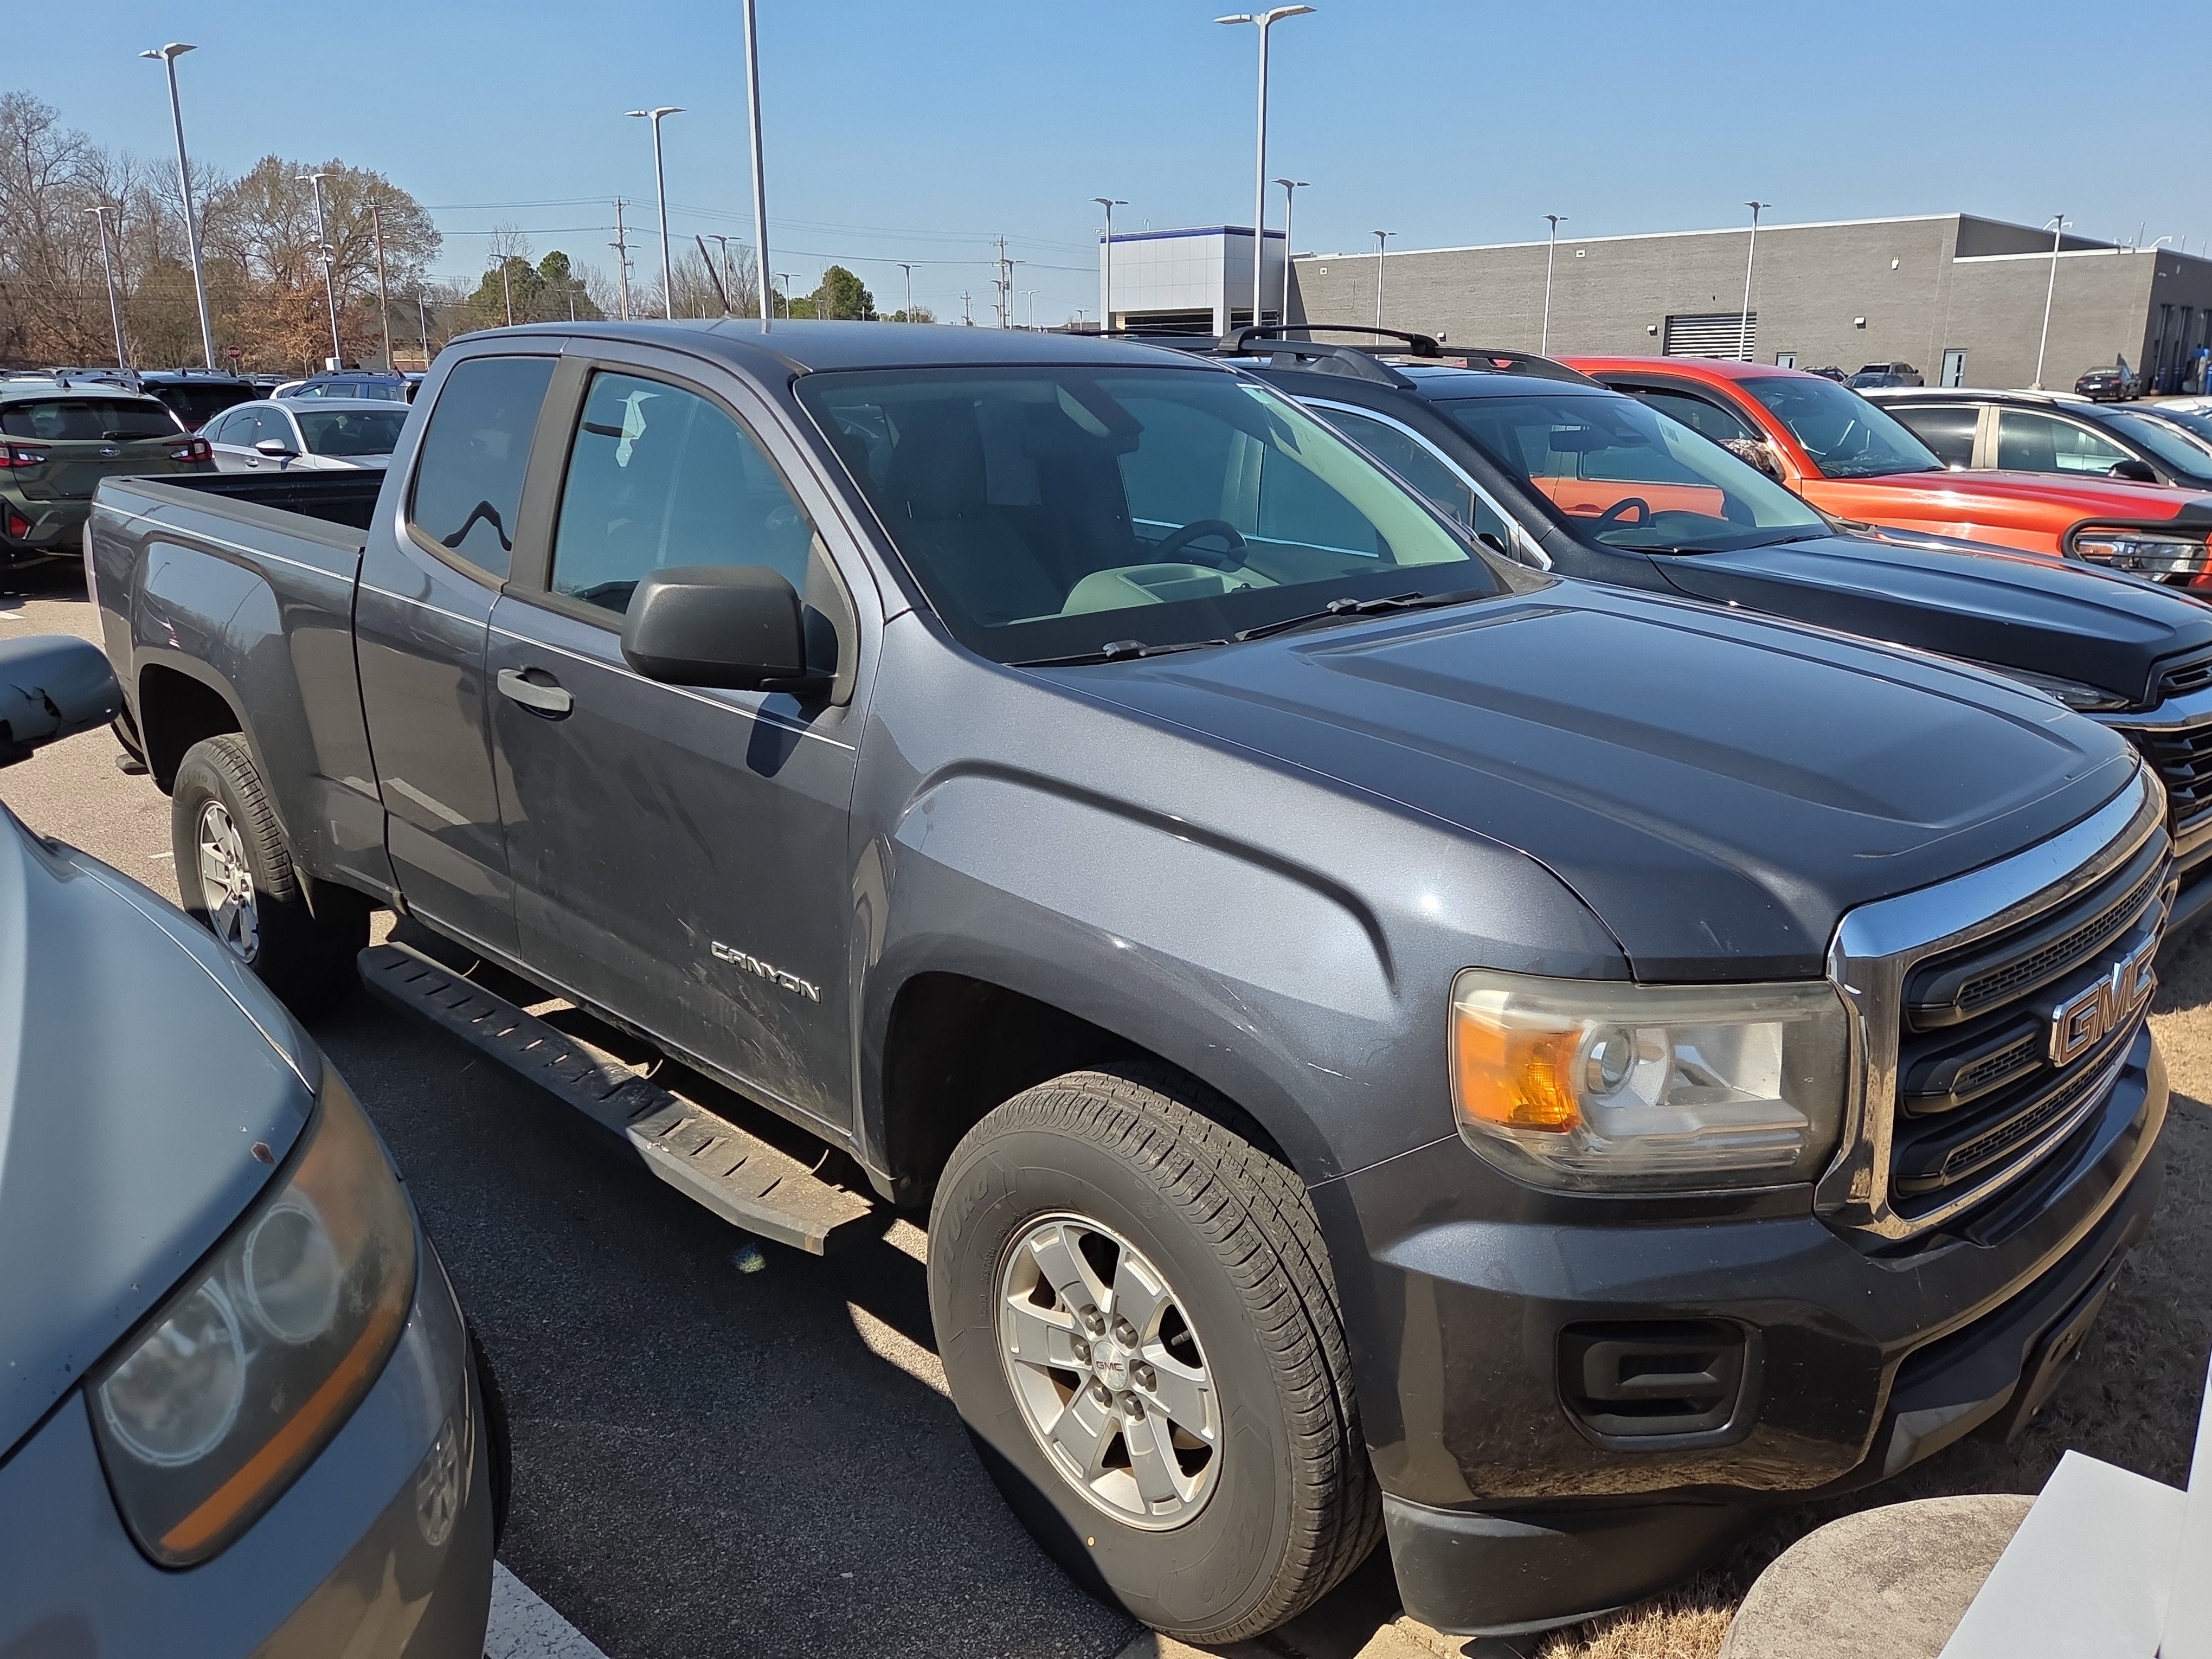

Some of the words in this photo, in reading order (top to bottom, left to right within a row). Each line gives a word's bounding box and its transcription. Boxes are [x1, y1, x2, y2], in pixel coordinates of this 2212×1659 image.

[711, 941, 821, 1004] CANYON
[2049, 933, 2156, 1068] GMC
[1096, 1361, 1124, 1372] GMC
